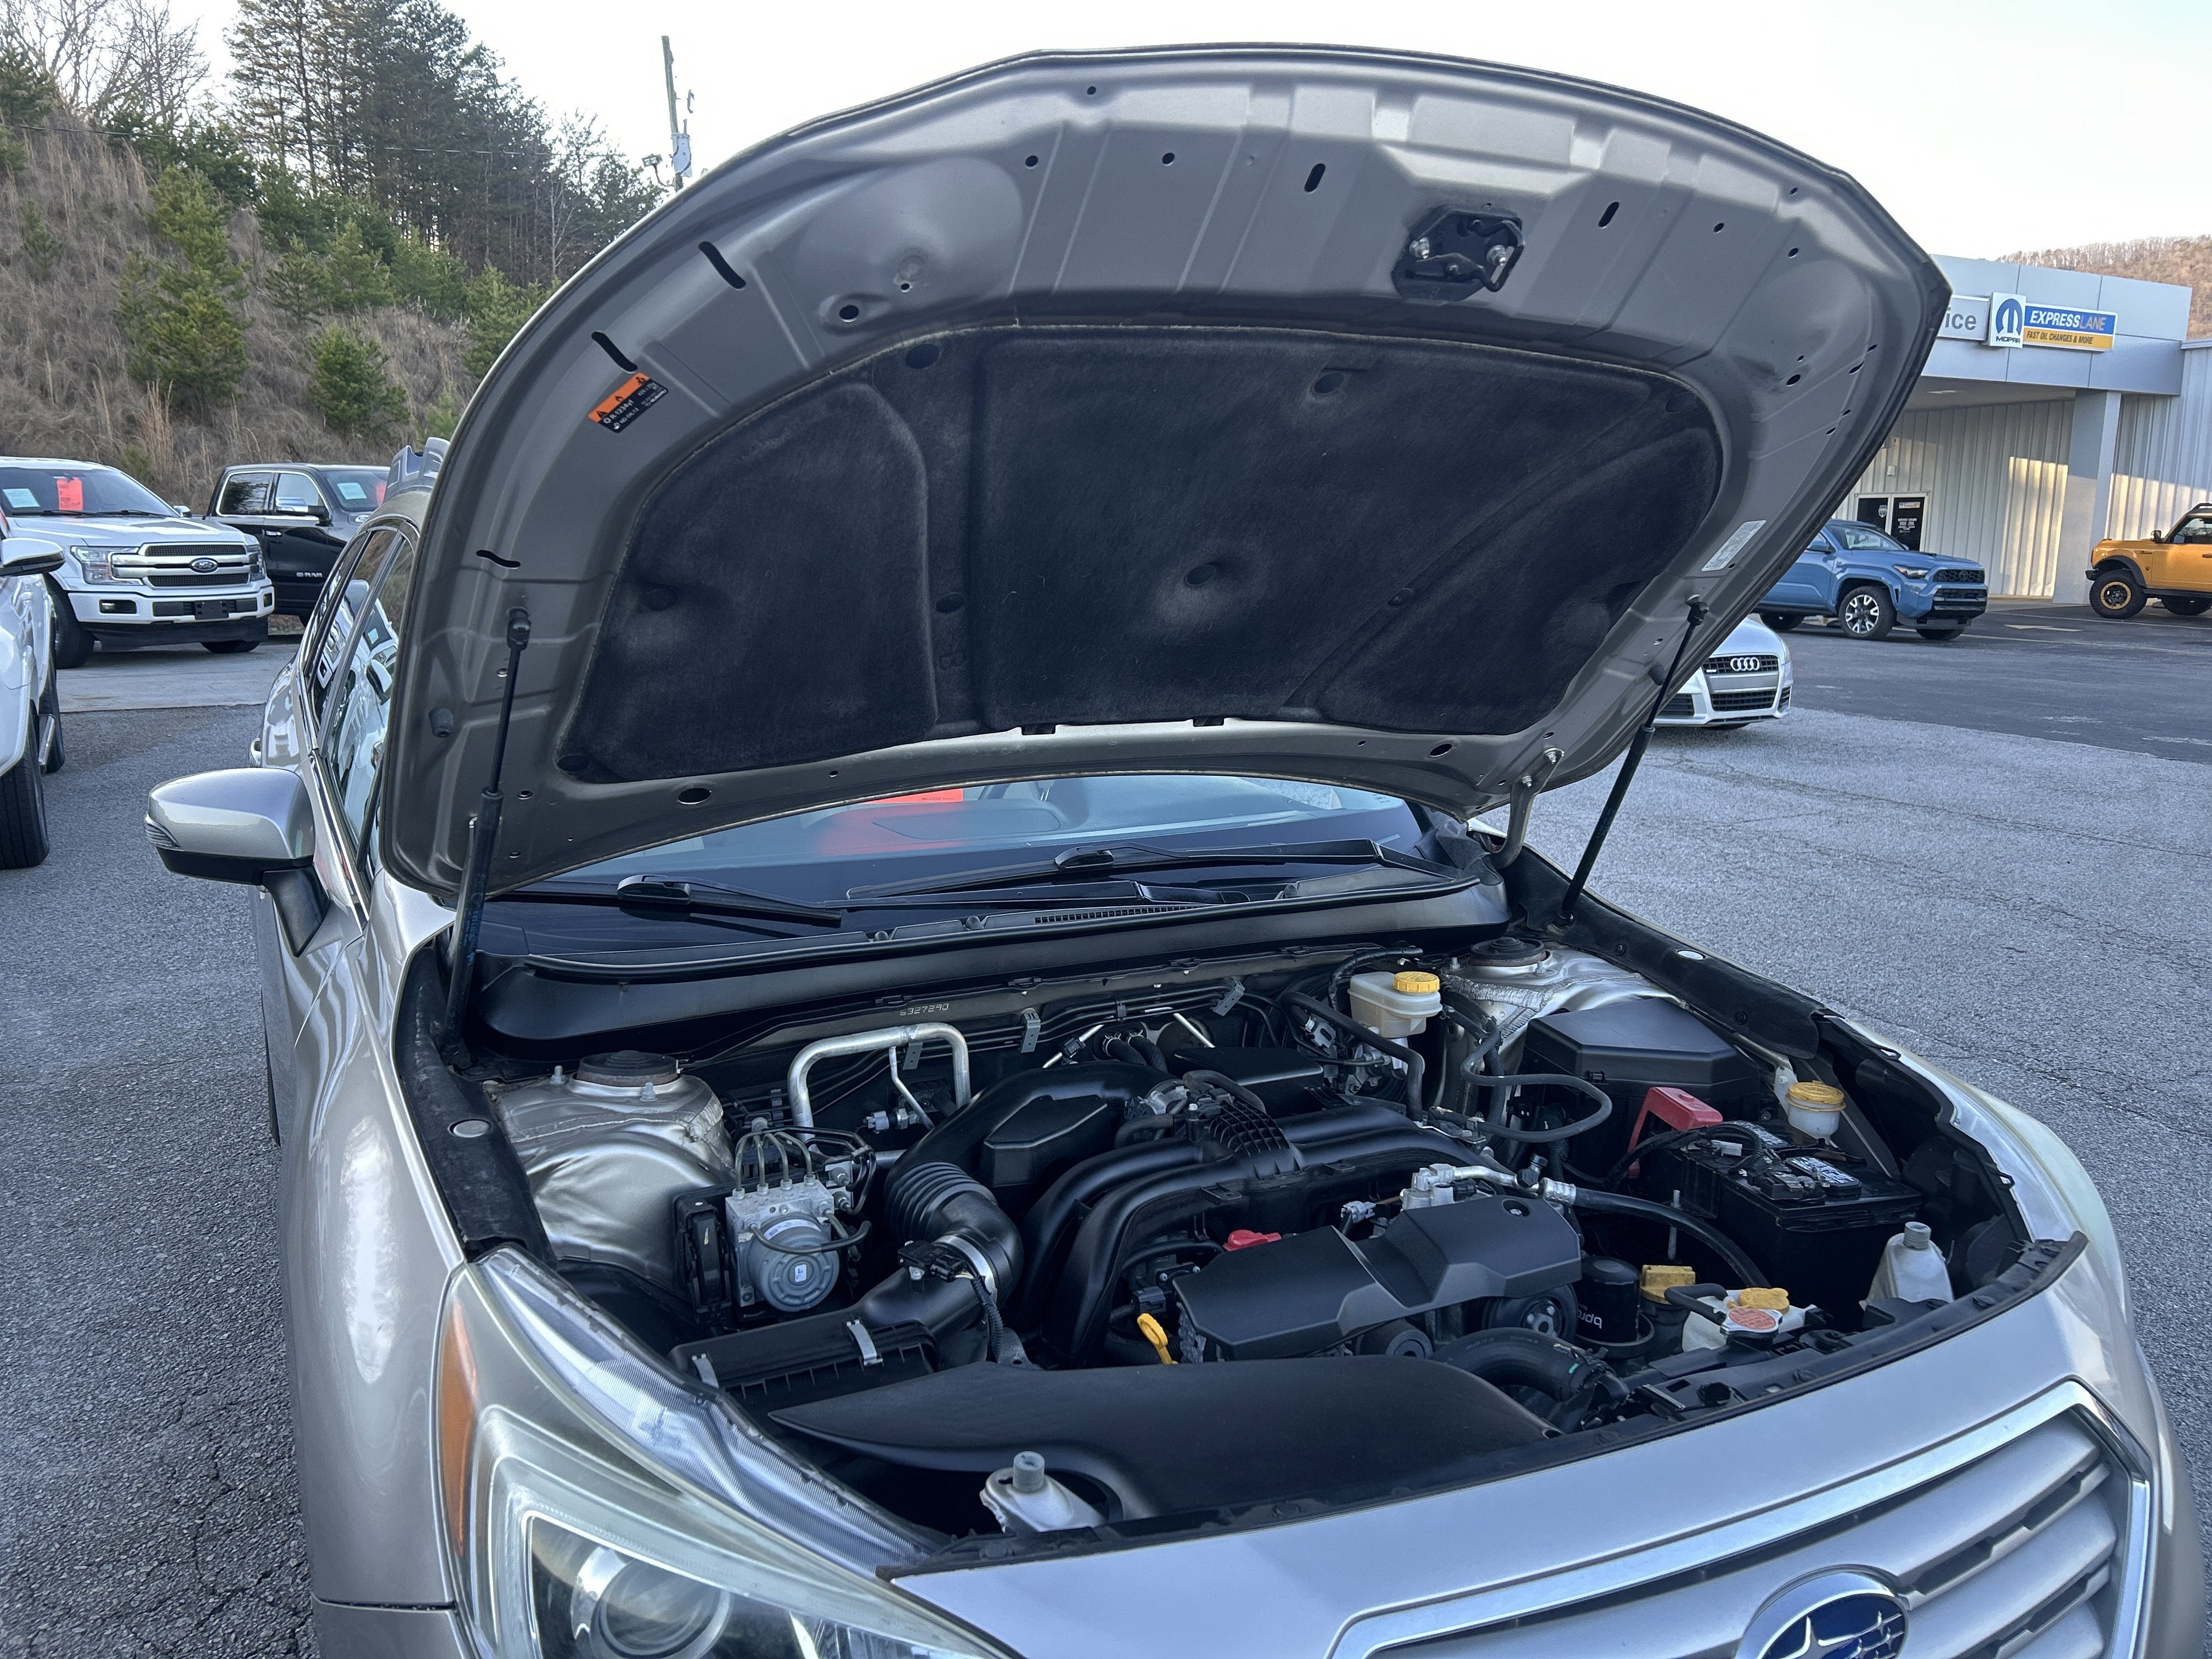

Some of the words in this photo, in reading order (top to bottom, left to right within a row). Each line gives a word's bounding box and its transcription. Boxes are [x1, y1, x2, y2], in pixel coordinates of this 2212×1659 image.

[1945, 307, 1977, 330] ice
[2027, 331, 2039, 339] FAST
[2049, 333, 2073, 342] CHANGES
[900, 1003, 949, 1016] 6327290
